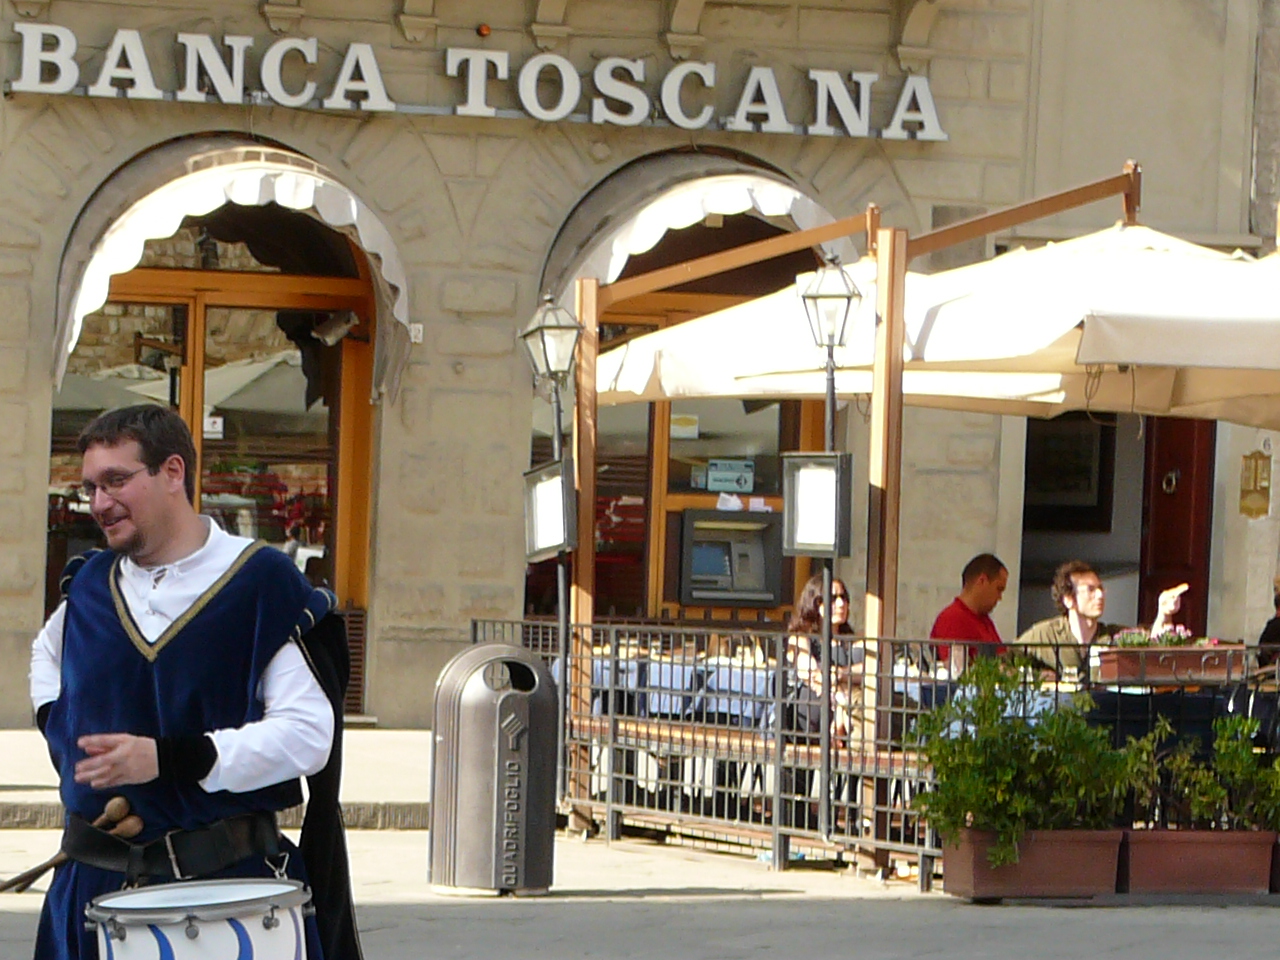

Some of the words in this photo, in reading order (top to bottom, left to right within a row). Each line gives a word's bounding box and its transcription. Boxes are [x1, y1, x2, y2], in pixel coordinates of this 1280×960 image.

[11, 22, 396, 112] BANCA
[446, 47, 950, 143] TOSCANA
[503, 760, 520, 887] QUADRIFOGLIO
